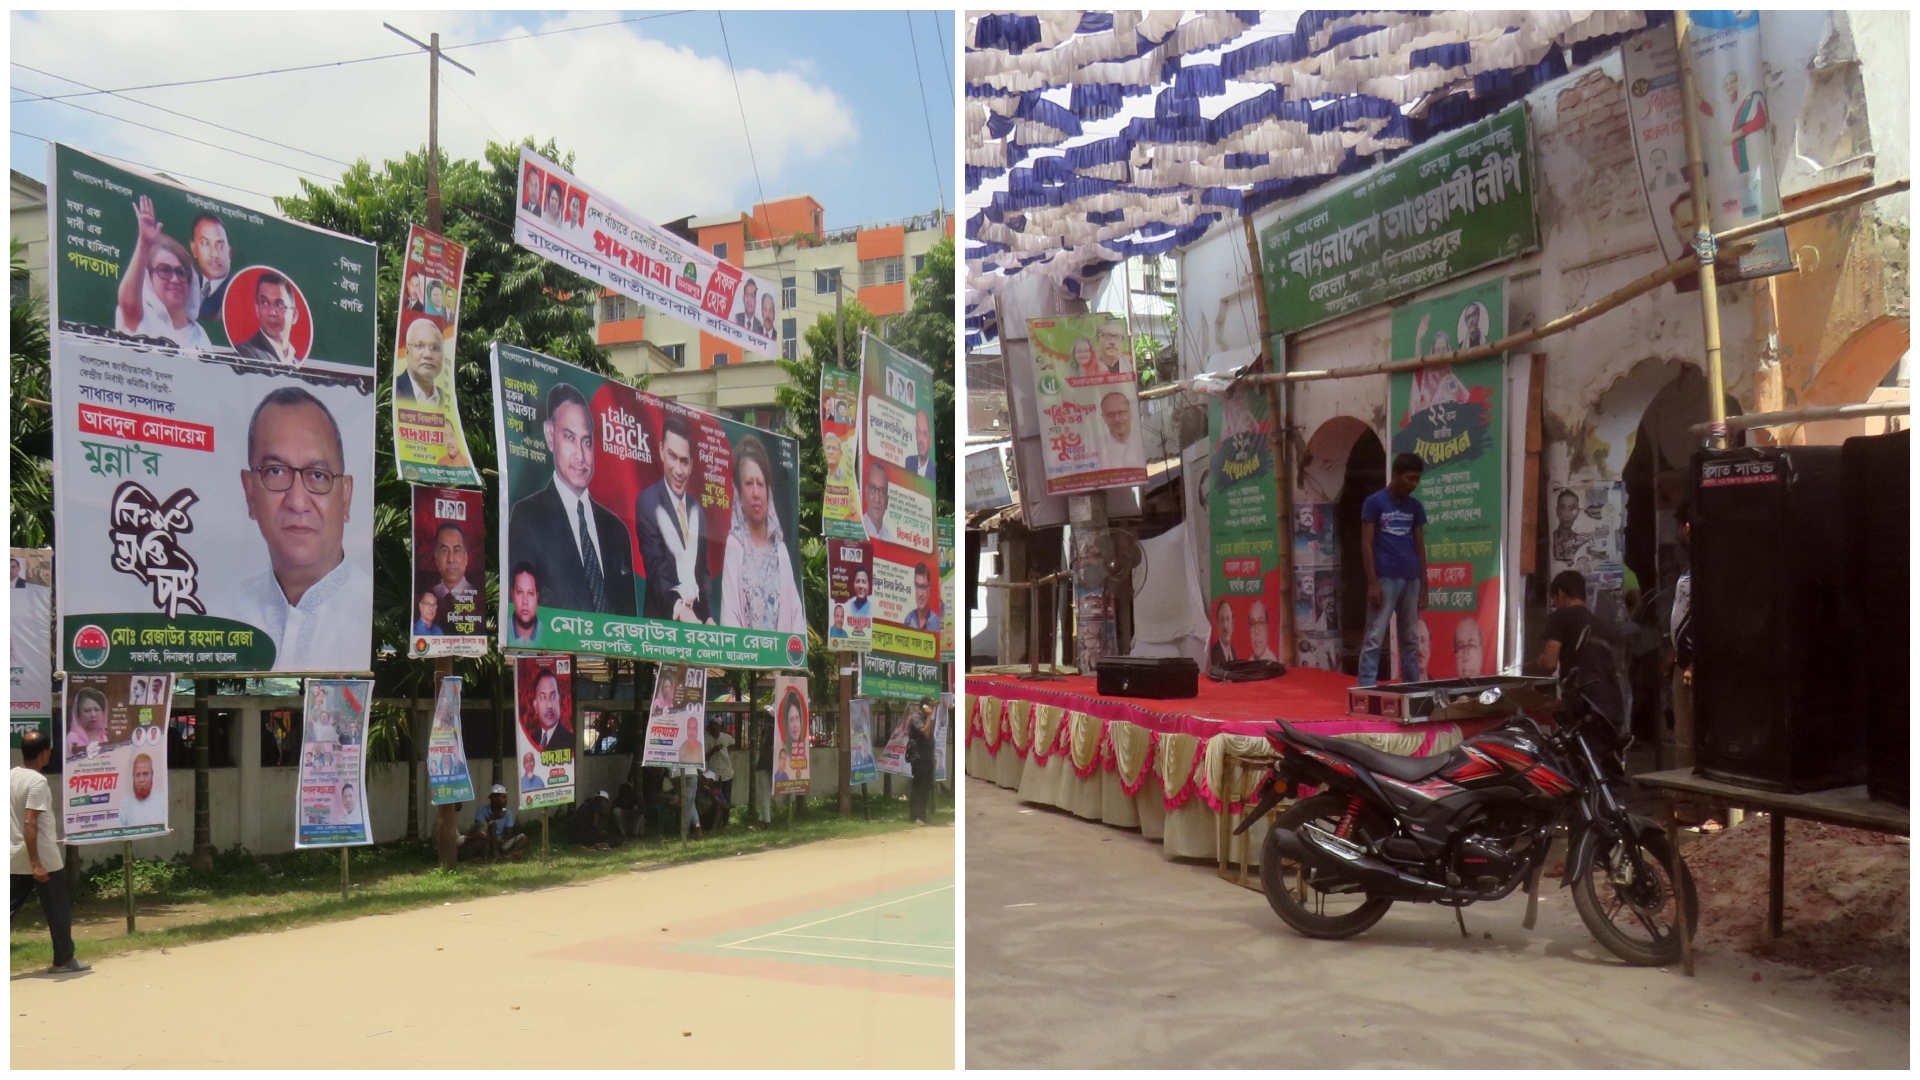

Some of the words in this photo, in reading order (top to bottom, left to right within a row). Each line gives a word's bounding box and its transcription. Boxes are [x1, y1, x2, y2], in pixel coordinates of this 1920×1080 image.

[1418, 153, 1451, 178] জয়
[66, 199, 84, 214] দফা
[86, 206, 102, 219] এক
[66, 215, 85, 231] দাবী
[87, 224, 103, 236] এক
[587, 204, 604, 225] দেশ
[605, 211, 630, 236] বাঁচাতে
[631, 230, 658, 252] মেহনতি
[658, 242, 683, 265] মানুষের
[1267, 230, 1290, 249] জয়
[1295, 210, 1329, 234] বাংলা
[67, 234, 84, 248] শেখ
[1289, 211, 1381, 280] বাংলাদেশ
[67, 251, 119, 280] পদত্যাগ
[340, 257, 361, 276] শিক্ষা
[593, 229, 674, 288] পদযাত্রা
[1308, 275, 1346, 302] জেলা
[1382, 228, 1463, 270] দিনাজপুর
[340, 278, 359, 293] ঐক্য
[527, 229, 602, 278] বাংলাদেশ
[607, 270, 702, 323] জাতীয়তাবাদী
[706, 317, 743, 340] শ্রমিক
[748, 336, 768, 350] দল
[714, 270, 737, 297] সফল
[339, 299, 364, 314] প্রগতি
[706, 291, 727, 315] হোক
[79, 355, 110, 370] বাংলাদেশ
[111, 361, 153, 378] জাতীয়তাবাদী
[155, 371, 173, 382] যুবদল
[79, 368, 102, 381] কেন্দ্রীয়
[104, 373, 124, 386] নির্বাহী
[126, 378, 149, 390] কমিটির
[78, 385, 123, 405] সাধারণ
[127, 393, 176, 415] সম্পাদক
[504, 376, 539, 400] জনগণই
[505, 388, 524, 404] সকল
[506, 400, 537, 421] ক্ষমতার
[607, 406, 636, 428] take
[82, 410, 138, 439] আবদুল
[142, 422, 207, 447] মোনায়েম
[507, 414, 524, 432] উৎস
[601, 413, 650, 452] back
[398, 426, 444, 445] পদযাত্রা
[1413, 430, 1472, 465] সম্মেলন
[602, 440, 653, 464] bangladesh
[716, 494, 730, 510] করি
[113, 531, 177, 583] মুক্তি
[1444, 567, 1466, 584] হোক
[1451, 591, 1473, 608] হোক
[111, 627, 136, 646] মোঃ
[140, 624, 186, 647] রেজাউর
[188, 630, 225, 649] রহমান
[228, 631, 254, 648] রেজা
[551, 615, 594, 636] মোঃ
[603, 619, 679, 643] রেজাউর
[684, 628, 737, 648] রহমান
[743, 633, 779, 652] রেজা
[130, 650, 161, 665] সভাপতি,
[163, 650, 194, 665] দিনাজপুর
[196, 652, 214, 663] জেলা
[215, 652, 237, 663] ছাত্রদল
[580, 638, 638, 656] সভাপতি,
[641, 641, 693, 660] দিনাজপুর
[697, 648, 722, 660] জেলা
[726, 649, 759, 663] ছাত্রদল
[864, 652, 896, 679] দিনাজপুর
[897, 661, 915, 678] জেলা
[917, 665, 938, 682] যুবদল
[650, 725, 680, 739] পদযাত্রা
[541, 748, 572, 767] পদযাত্রা
[69, 773, 119, 795] পদযাত্রা
